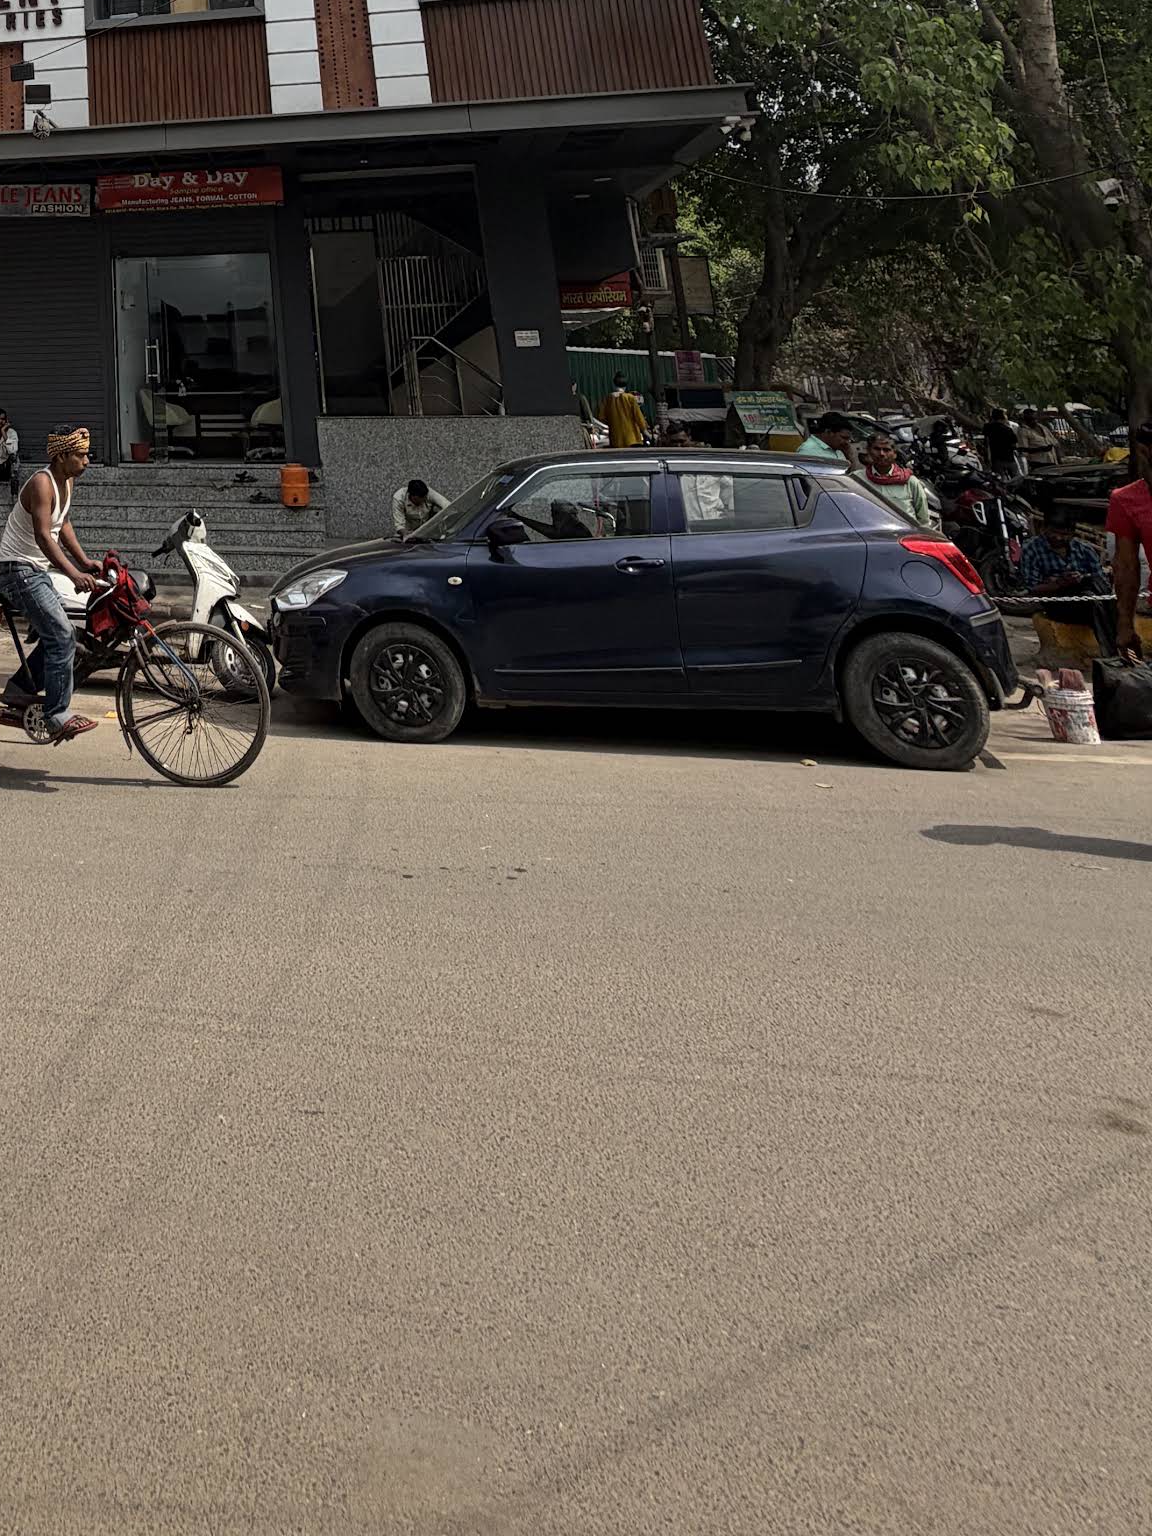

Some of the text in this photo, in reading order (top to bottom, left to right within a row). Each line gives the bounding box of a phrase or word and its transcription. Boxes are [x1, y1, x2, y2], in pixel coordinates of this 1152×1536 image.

[133, 172, 176, 190] Day
[182, 170, 199, 185] &
[206, 170, 249, 186] Day
[23, 185, 82, 207] JEANS
[121, 197, 169, 206] Manufacturing
[228, 193, 257, 201] COTTON
[32, 204, 83, 213] FASHION
[562, 292, 585, 304] भारत
